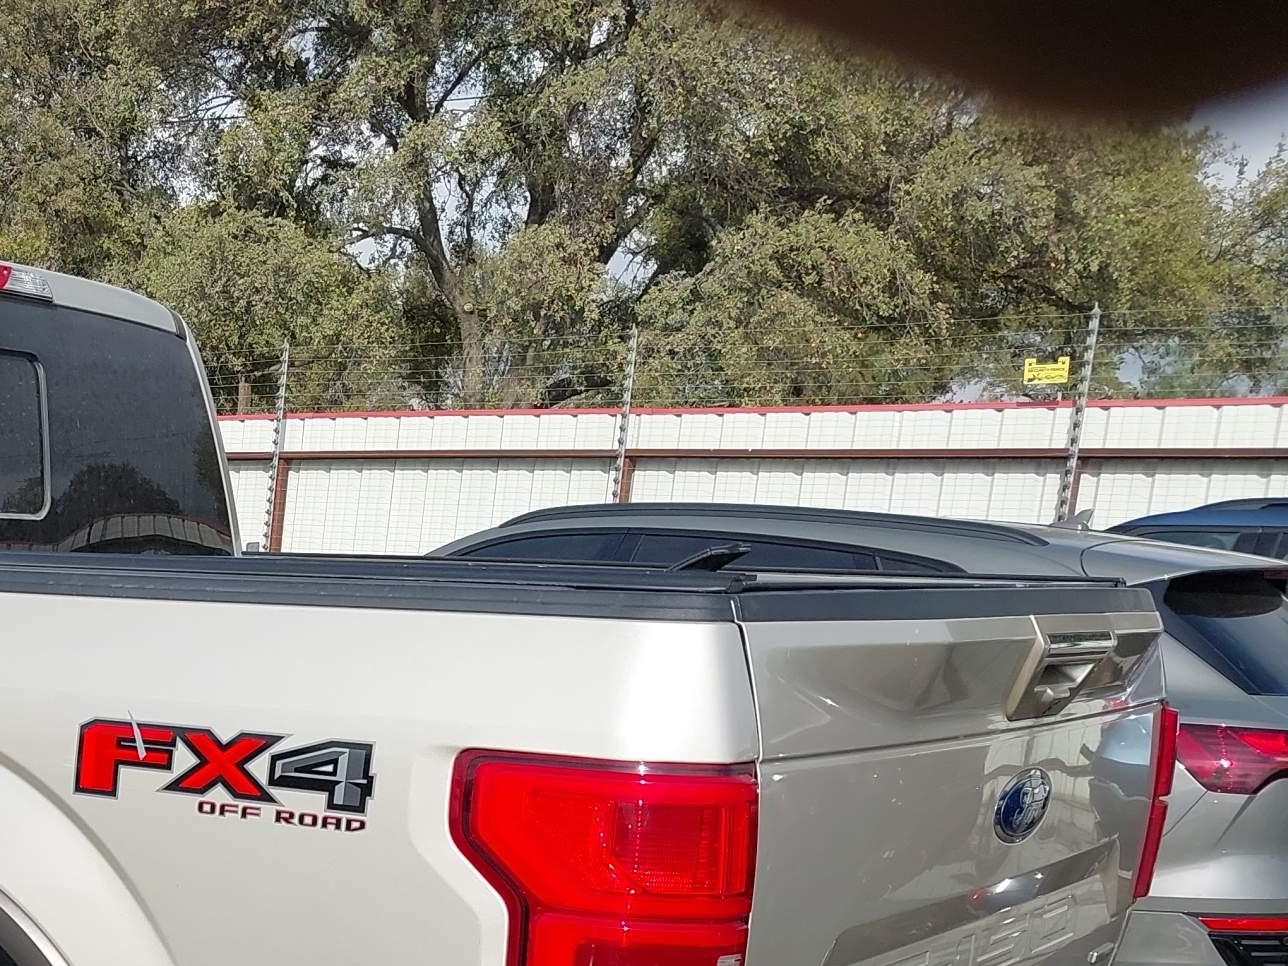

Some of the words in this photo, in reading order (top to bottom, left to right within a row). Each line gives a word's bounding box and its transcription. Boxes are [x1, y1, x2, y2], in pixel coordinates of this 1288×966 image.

[73, 716, 375, 816] FX4
[197, 800, 262, 820] OFF
[274, 808, 366, 832] ROAD
